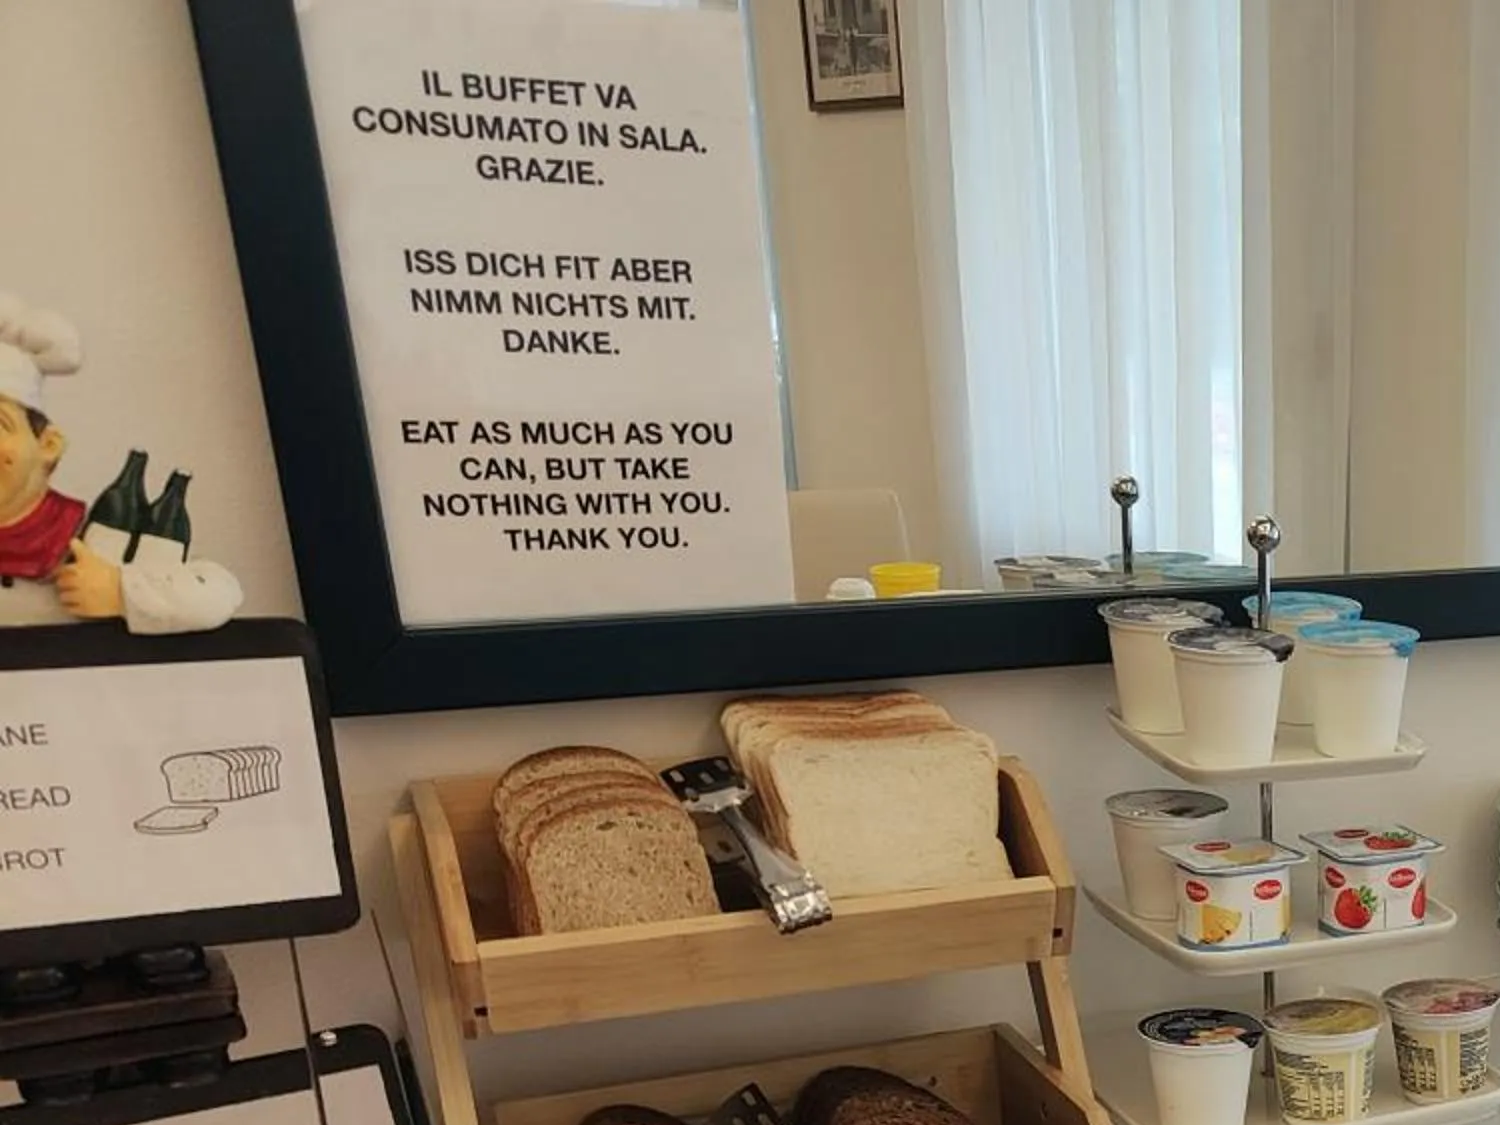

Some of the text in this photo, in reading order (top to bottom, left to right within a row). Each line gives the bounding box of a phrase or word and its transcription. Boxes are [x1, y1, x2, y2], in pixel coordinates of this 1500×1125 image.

[422, 70, 637, 111] IL BUFFET VA
[352, 106, 707, 154] CONSUMATO IN SALA.
[476, 154, 604, 186] GRAZIE.
[404, 249, 693, 284] ISS DICH FIT ABER
[410, 288, 696, 321] NIMM NICHTS MIT.
[502, 329, 620, 355] DANKE.
[400, 420, 733, 446] EAT AS MUCH AS YOU
[459, 457, 690, 485] CAN, BUT TAKE
[423, 491, 730, 517] NOTHING WITH YOU.
[503, 526, 689, 551] THANK YOU.
[0, 723, 49, 746] NE
[0, 847, 66, 872] ROT
